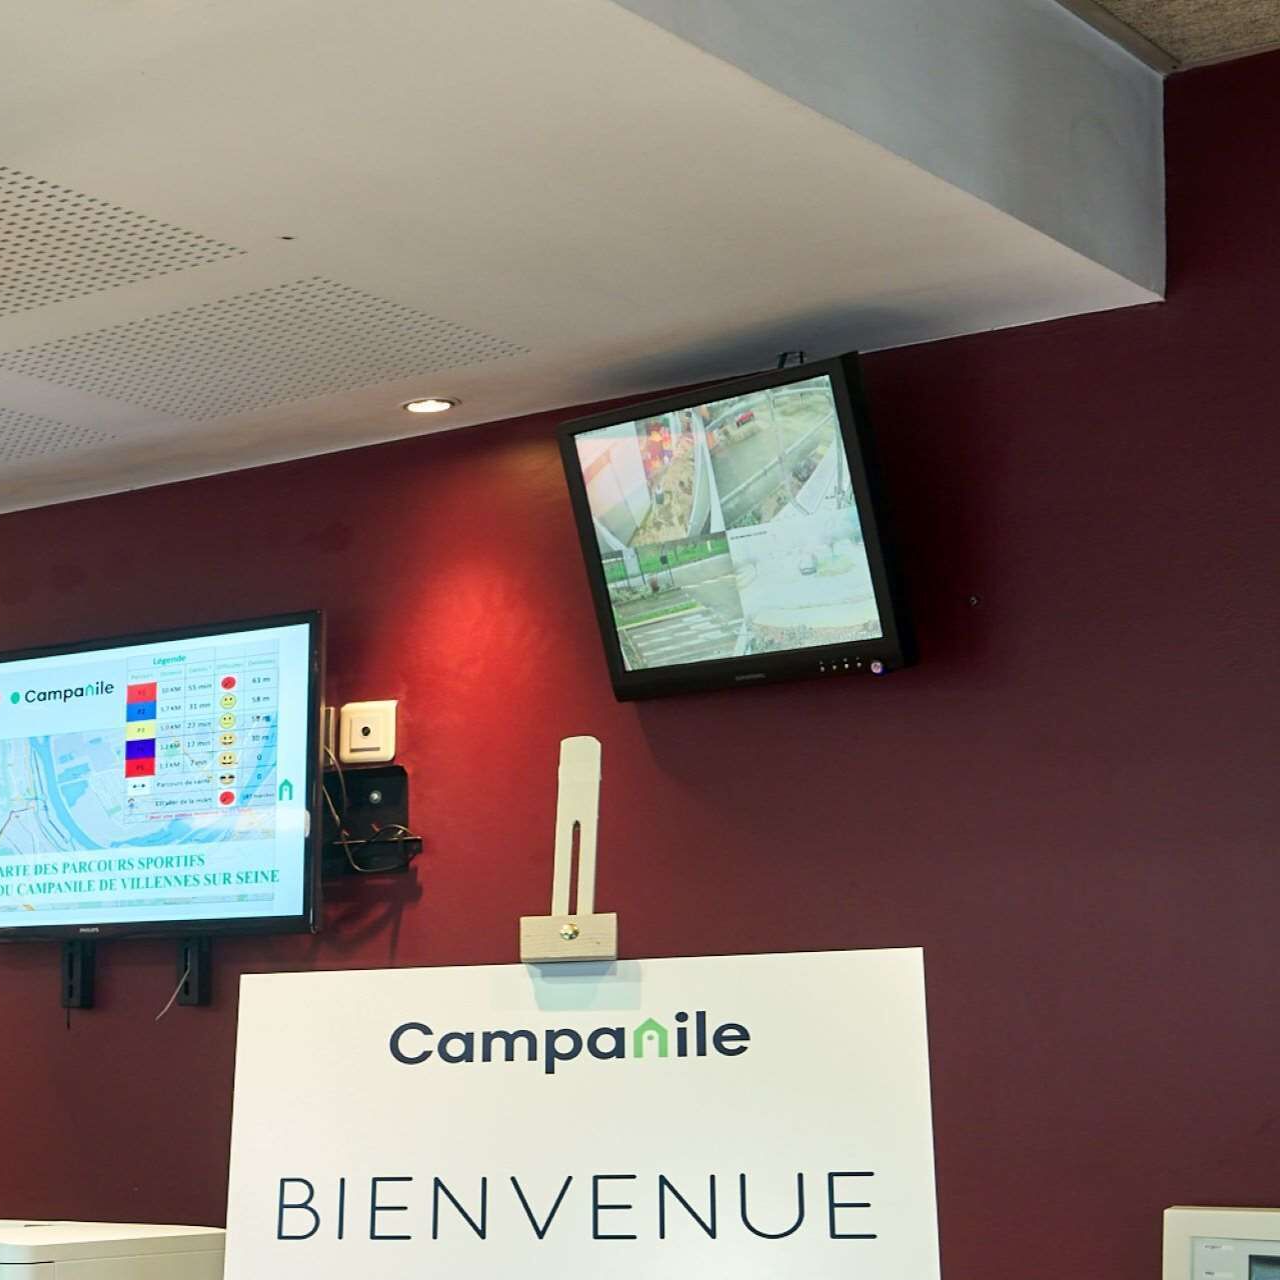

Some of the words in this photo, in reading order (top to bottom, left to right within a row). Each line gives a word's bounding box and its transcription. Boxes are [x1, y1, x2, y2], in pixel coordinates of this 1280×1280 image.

[25, 681, 114, 703] Campanile
[34, 862, 58, 876] DES
[62, 857, 134, 874] PARCOURS
[135, 854, 206, 870] SPORTIFS
[16, 879, 96, 895] CAMPANILE
[99, 878, 118, 891] DE
[121, 873, 200, 890] VILLENNES
[203, 871, 232, 886] SUR
[235, 869, 280, 884] SEINE
[389, 1010, 751, 1075] Campanile
[276, 1171, 877, 1242] BIENVENUE
